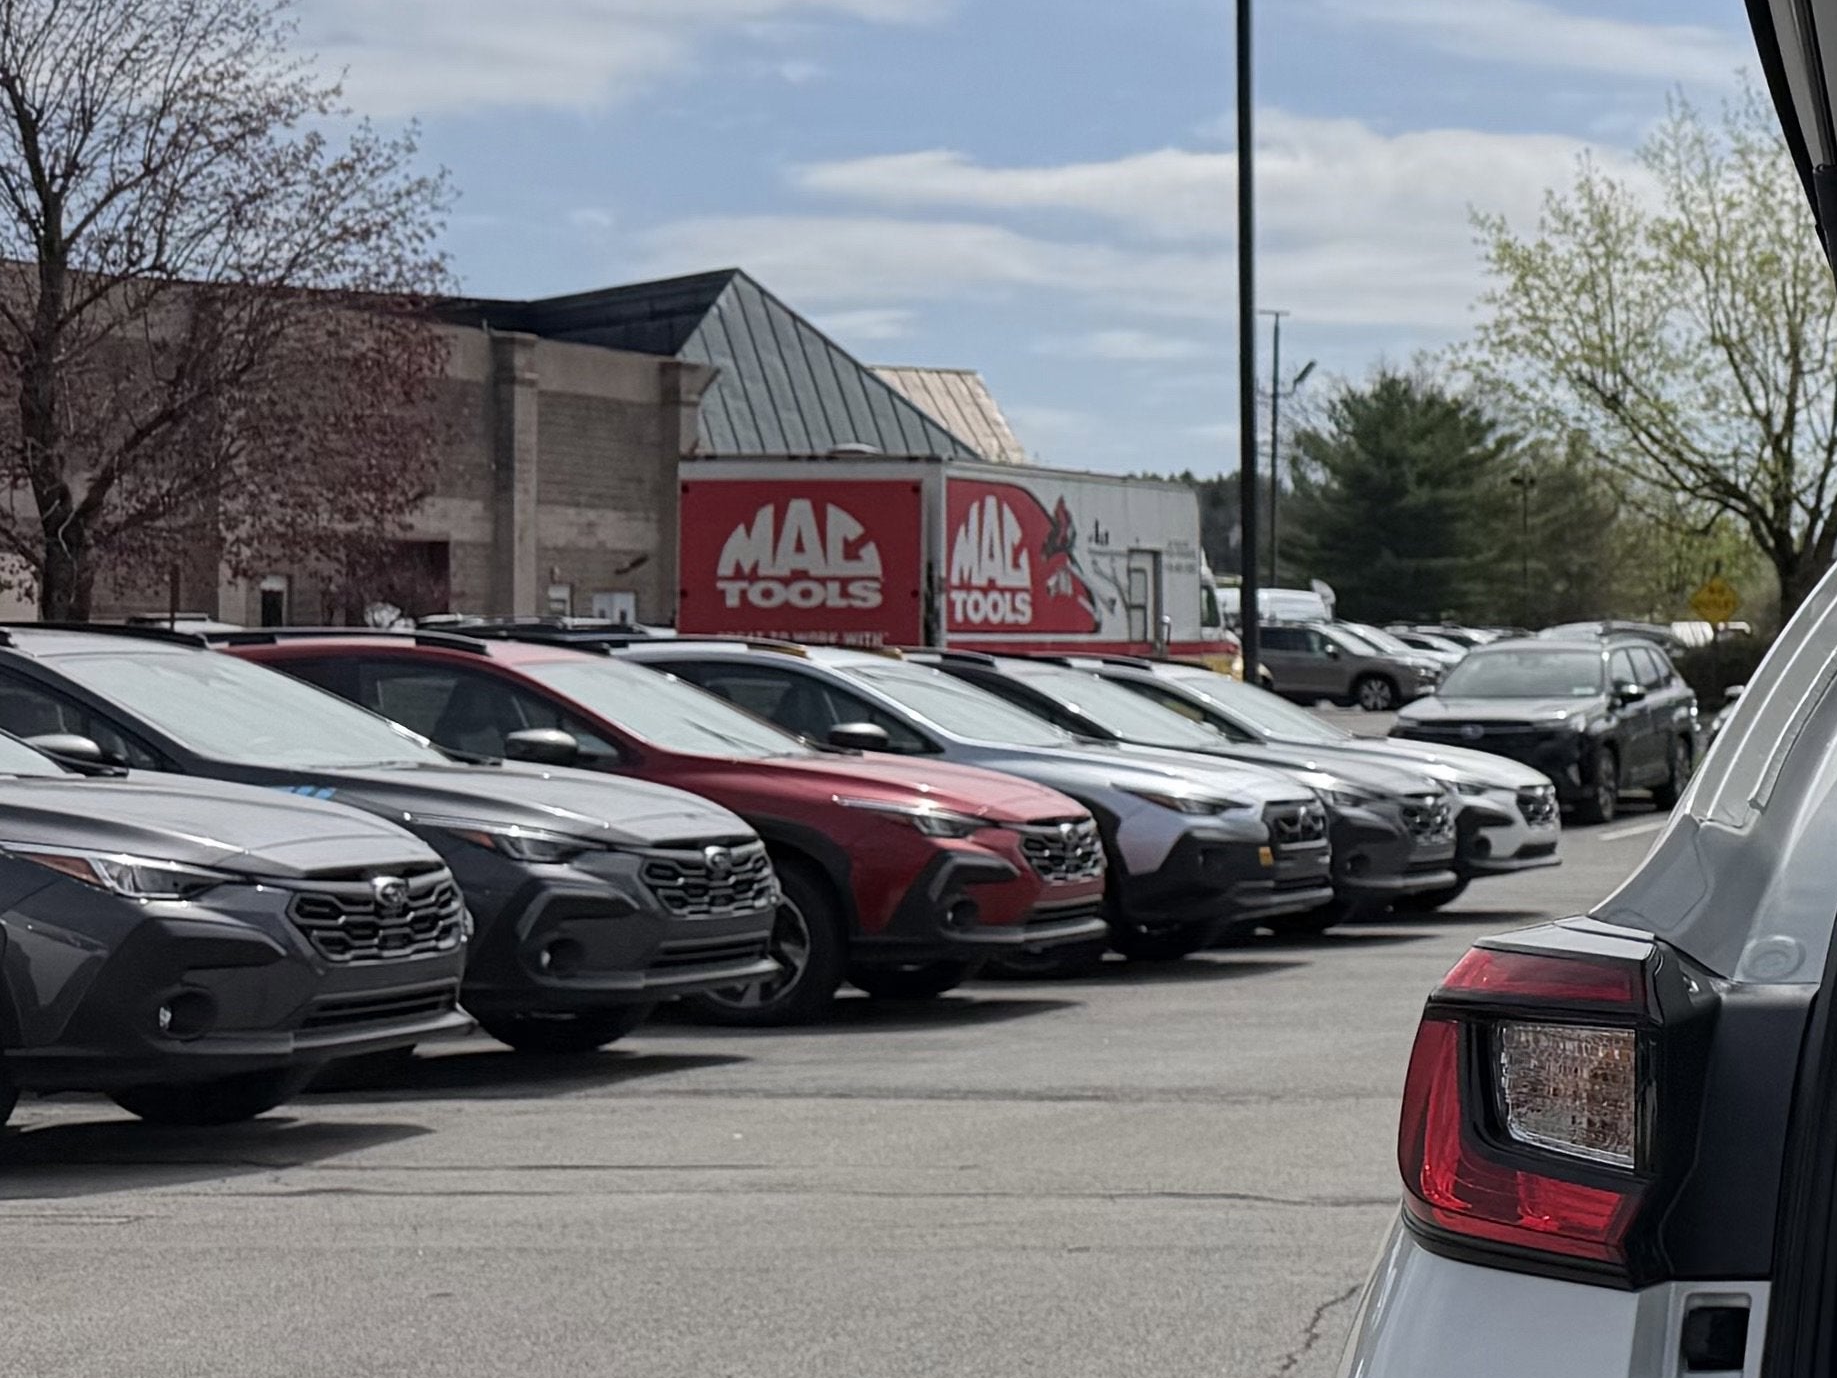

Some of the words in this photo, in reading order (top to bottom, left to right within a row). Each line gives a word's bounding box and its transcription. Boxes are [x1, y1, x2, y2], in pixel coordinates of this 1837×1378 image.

[716, 498, 883, 578] MAC
[952, 495, 1032, 588] MAC
[716, 580, 883, 609] TOOLS
[951, 590, 1032, 625] TOOLS
